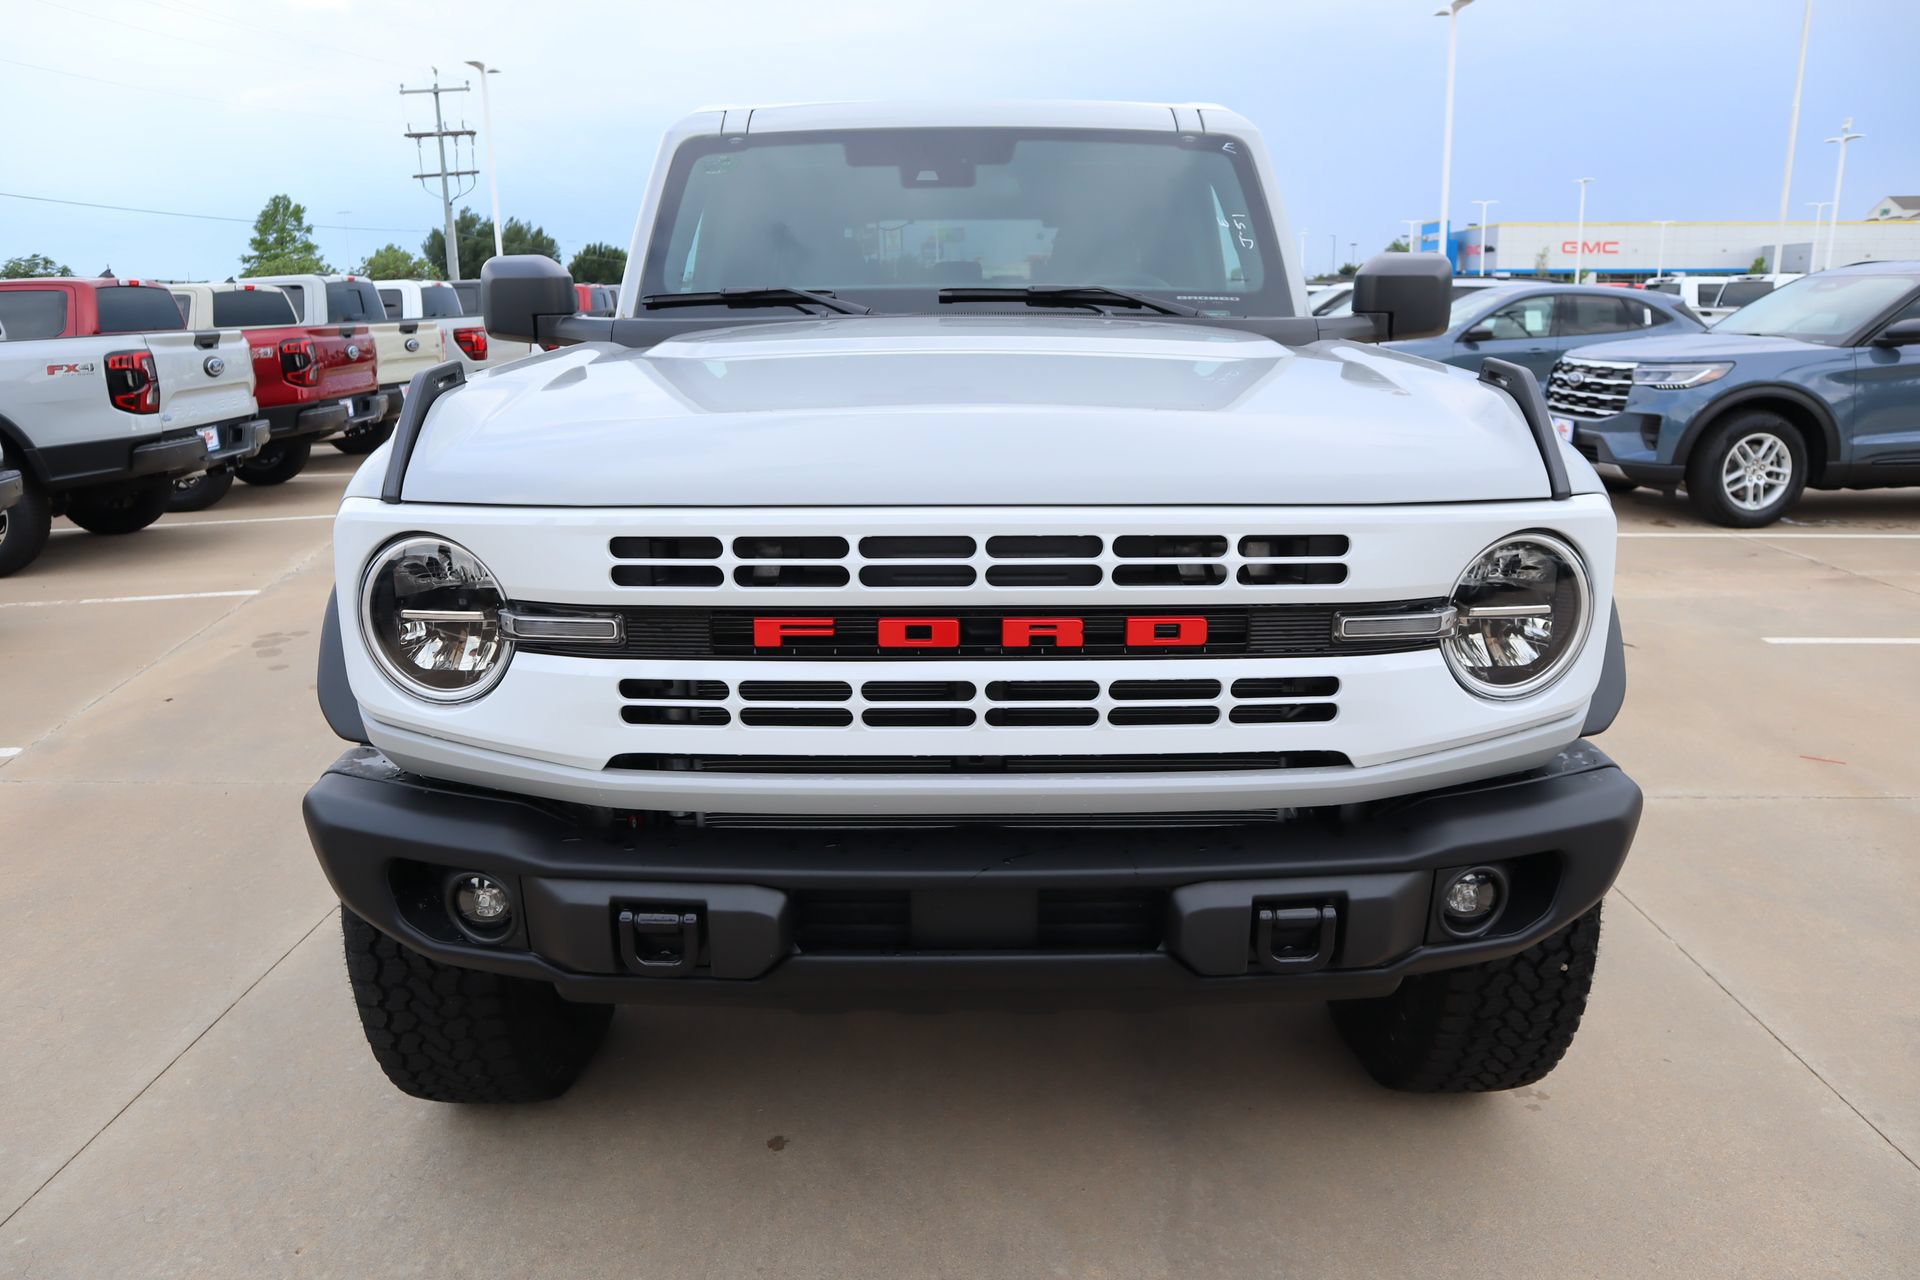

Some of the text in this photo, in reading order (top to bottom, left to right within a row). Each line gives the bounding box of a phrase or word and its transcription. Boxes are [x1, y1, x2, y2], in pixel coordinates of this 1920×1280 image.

[1561, 241, 1619, 255] GMC
[47, 363, 95, 376] FX4
[754, 617, 1208, 647] FORD
